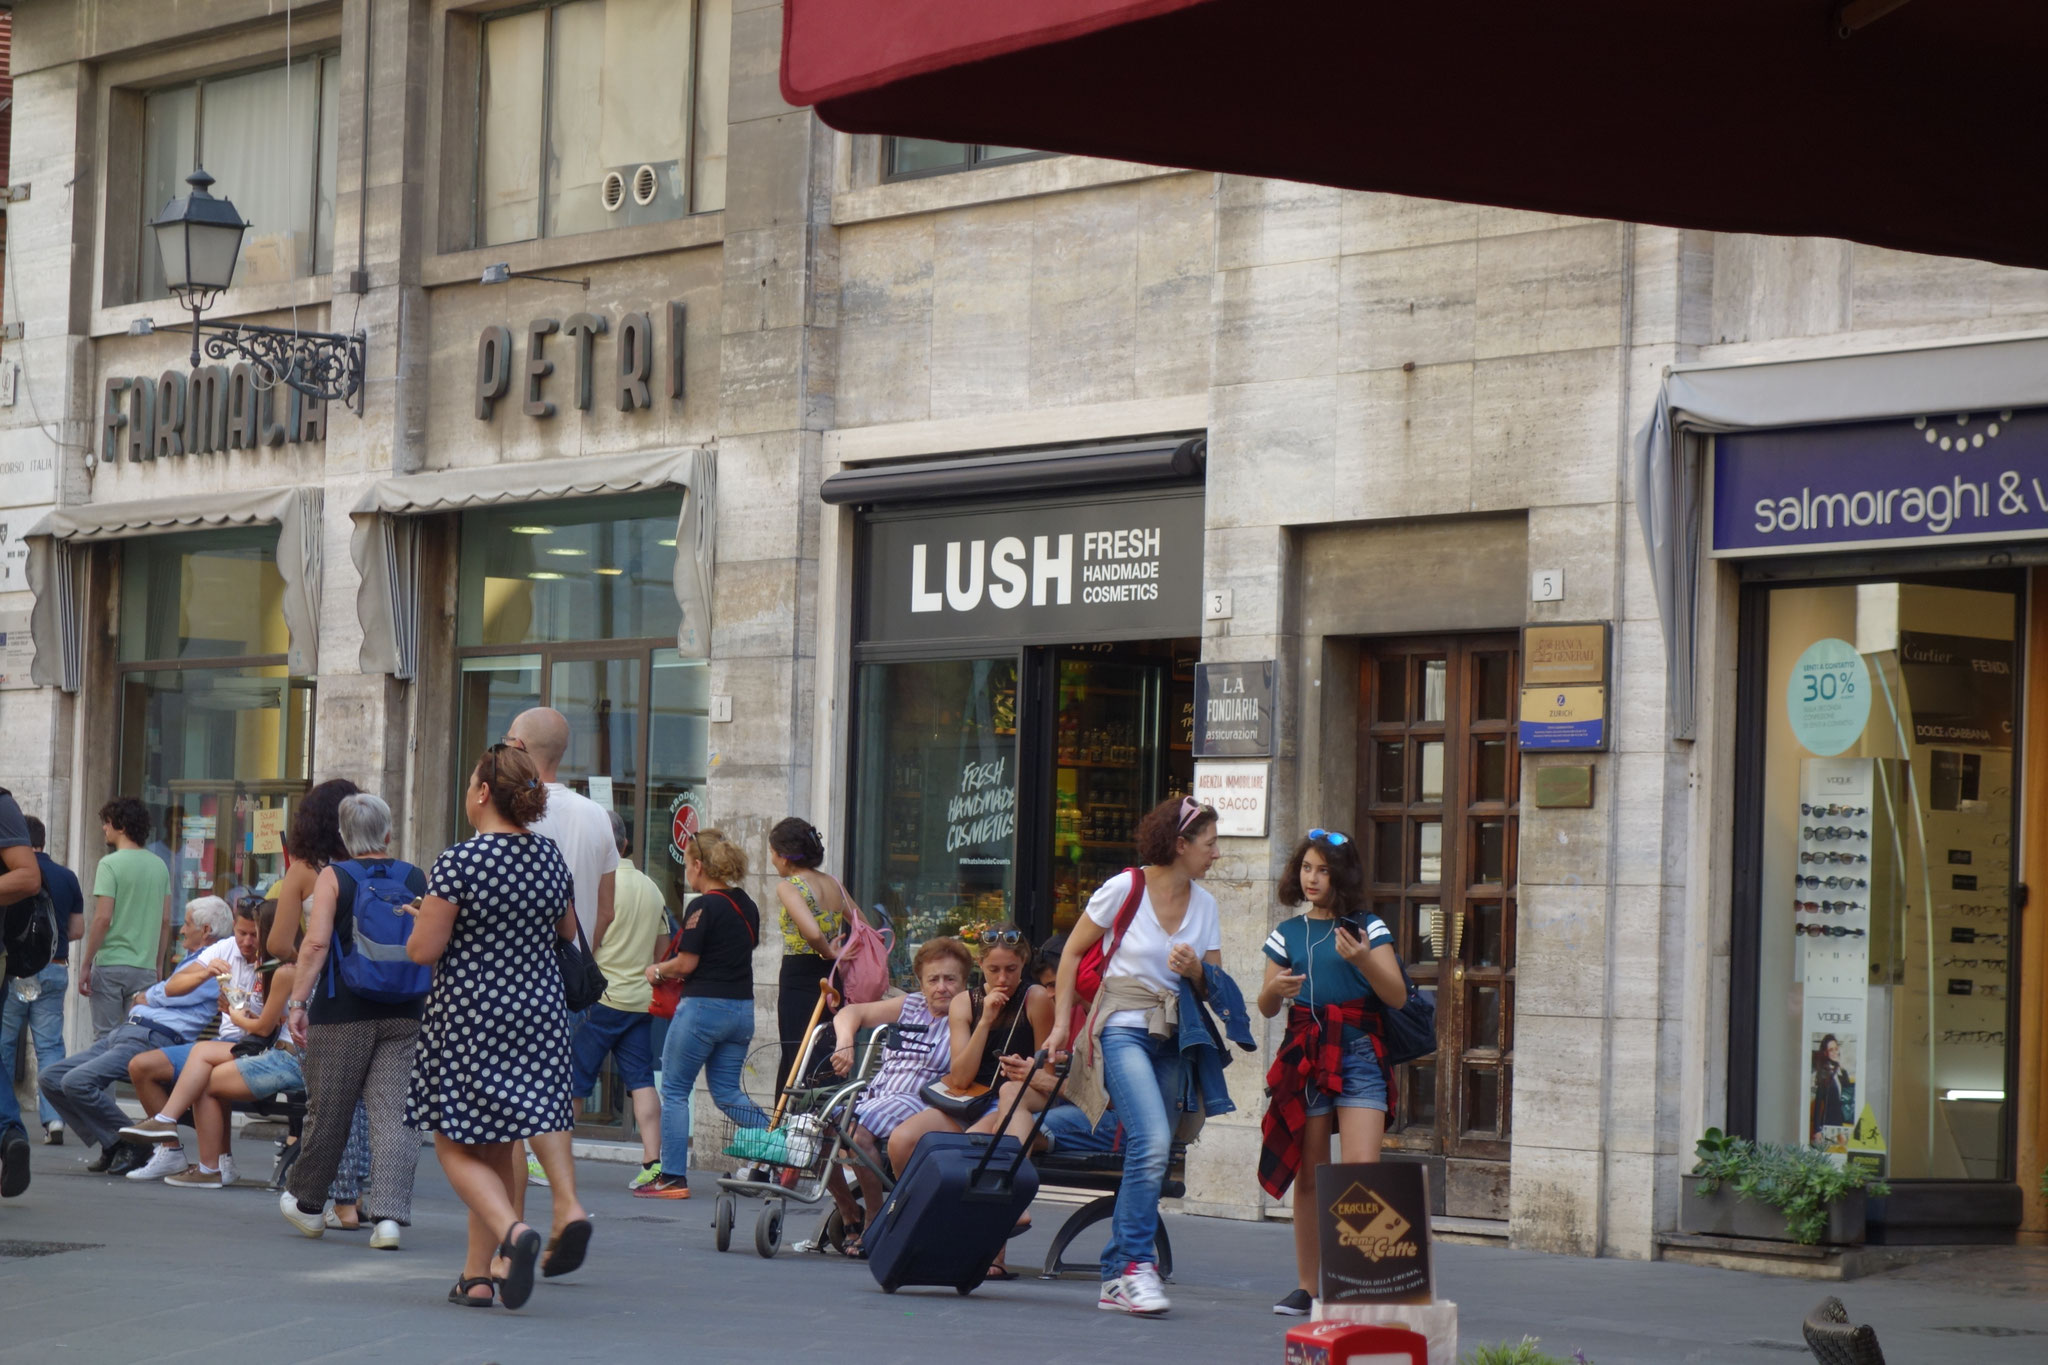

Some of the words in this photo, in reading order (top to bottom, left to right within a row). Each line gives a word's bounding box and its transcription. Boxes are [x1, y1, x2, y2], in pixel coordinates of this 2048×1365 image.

[475, 301, 686, 421] PETRI
[102, 356, 327, 462] FARMACIA
[30, 459, 52, 472] ITALIA
[1755, 475, 1989, 533] salmoiraghi
[1999, 470, 2029, 515] &
[1084, 528, 1160, 560] FRESH
[911, 534, 1073, 613] LUSH
[1083, 561, 1159, 582] HANDMADE
[1083, 583, 1158, 603] COSMETICS
[1543, 578, 1552, 596] 5
[1214, 595, 1222, 613] 3
[1554, 639, 1582, 650] BANCA
[1904, 643, 1953, 663] Cartier
[1554, 650, 1594, 662] GENERALI
[1972, 659, 2010, 674] FENDI
[1223, 678, 1245, 694] LA
[1803, 672, 1855, 702] 30%
[1206, 698, 1259, 721] FONDIARIA
[1206, 727, 1258, 740] assicurazioni
[962, 757, 1005, 793] FRESH
[1199, 775, 1222, 788] AGENZIA
[1226, 775, 1264, 789] IMMOBILIARE
[948, 786, 1014, 822] HANDMADE
[1219, 797, 1257, 810] SACCO
[947, 812, 1013, 853] COSMETICS
[1338, 1203, 1379, 1214] ERACLEA
[1339, 1232, 1375, 1247] Crema
[1374, 1238, 1418, 1257] Caffè
[1359, 1287, 1393, 1295] AVVOLGENTE
[1373, 1278, 1391, 1286] DELLA
